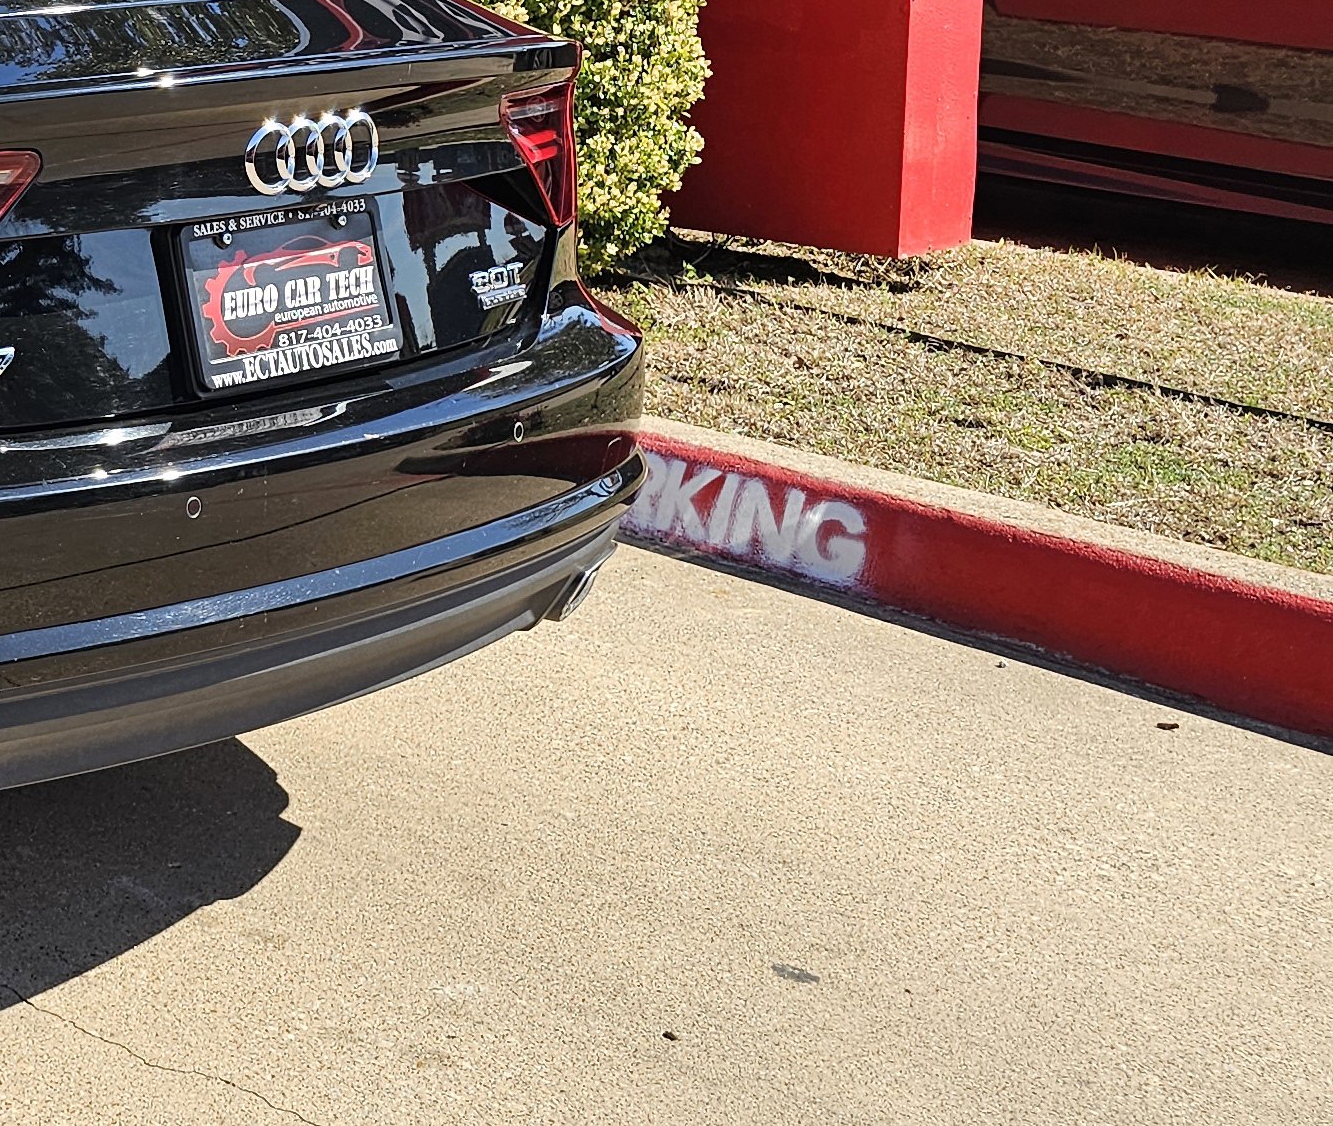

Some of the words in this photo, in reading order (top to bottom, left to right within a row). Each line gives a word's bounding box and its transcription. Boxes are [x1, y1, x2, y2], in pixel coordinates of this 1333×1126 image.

[193, 220, 226, 237] SALES
[228, 218, 238, 232] &
[239, 211, 286, 230] SERVICE
[223, 283, 279, 321] EURO
[284, 276, 322, 308] CAR
[326, 265, 375, 300] TECH
[274, 305, 322, 323] european
[323, 292, 379, 313] automotive
[278, 315, 383, 347] 817-404-4033
[211, 333, 399, 389] www.ECTAUTOSALES.com
